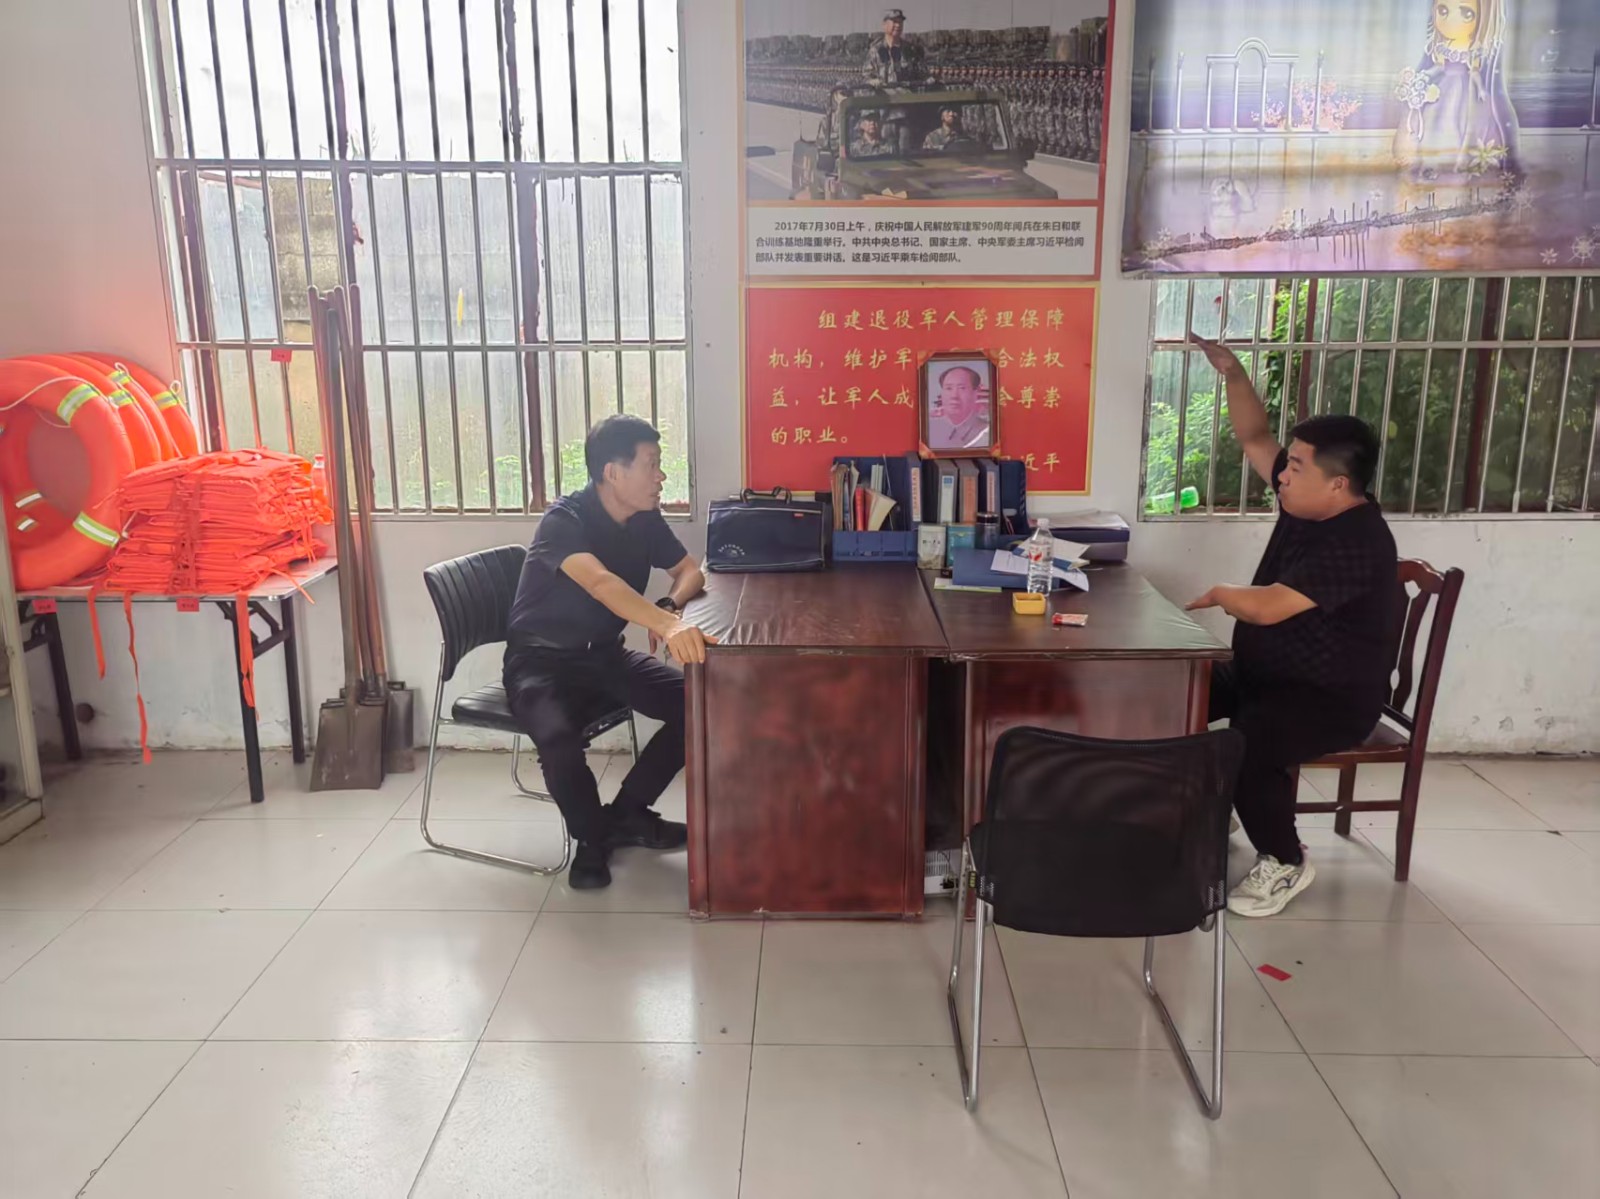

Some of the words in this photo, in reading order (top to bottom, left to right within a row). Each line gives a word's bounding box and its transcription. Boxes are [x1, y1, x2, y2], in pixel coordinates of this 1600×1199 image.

[818, 307, 1066, 331] 组建退役军人管理保障
[768, 347, 1066, 370] 机构，维护军合法权
[769, 385, 1062, 409] 益，让军人成会尊崇
[770, 425, 850, 446] 的职业。
